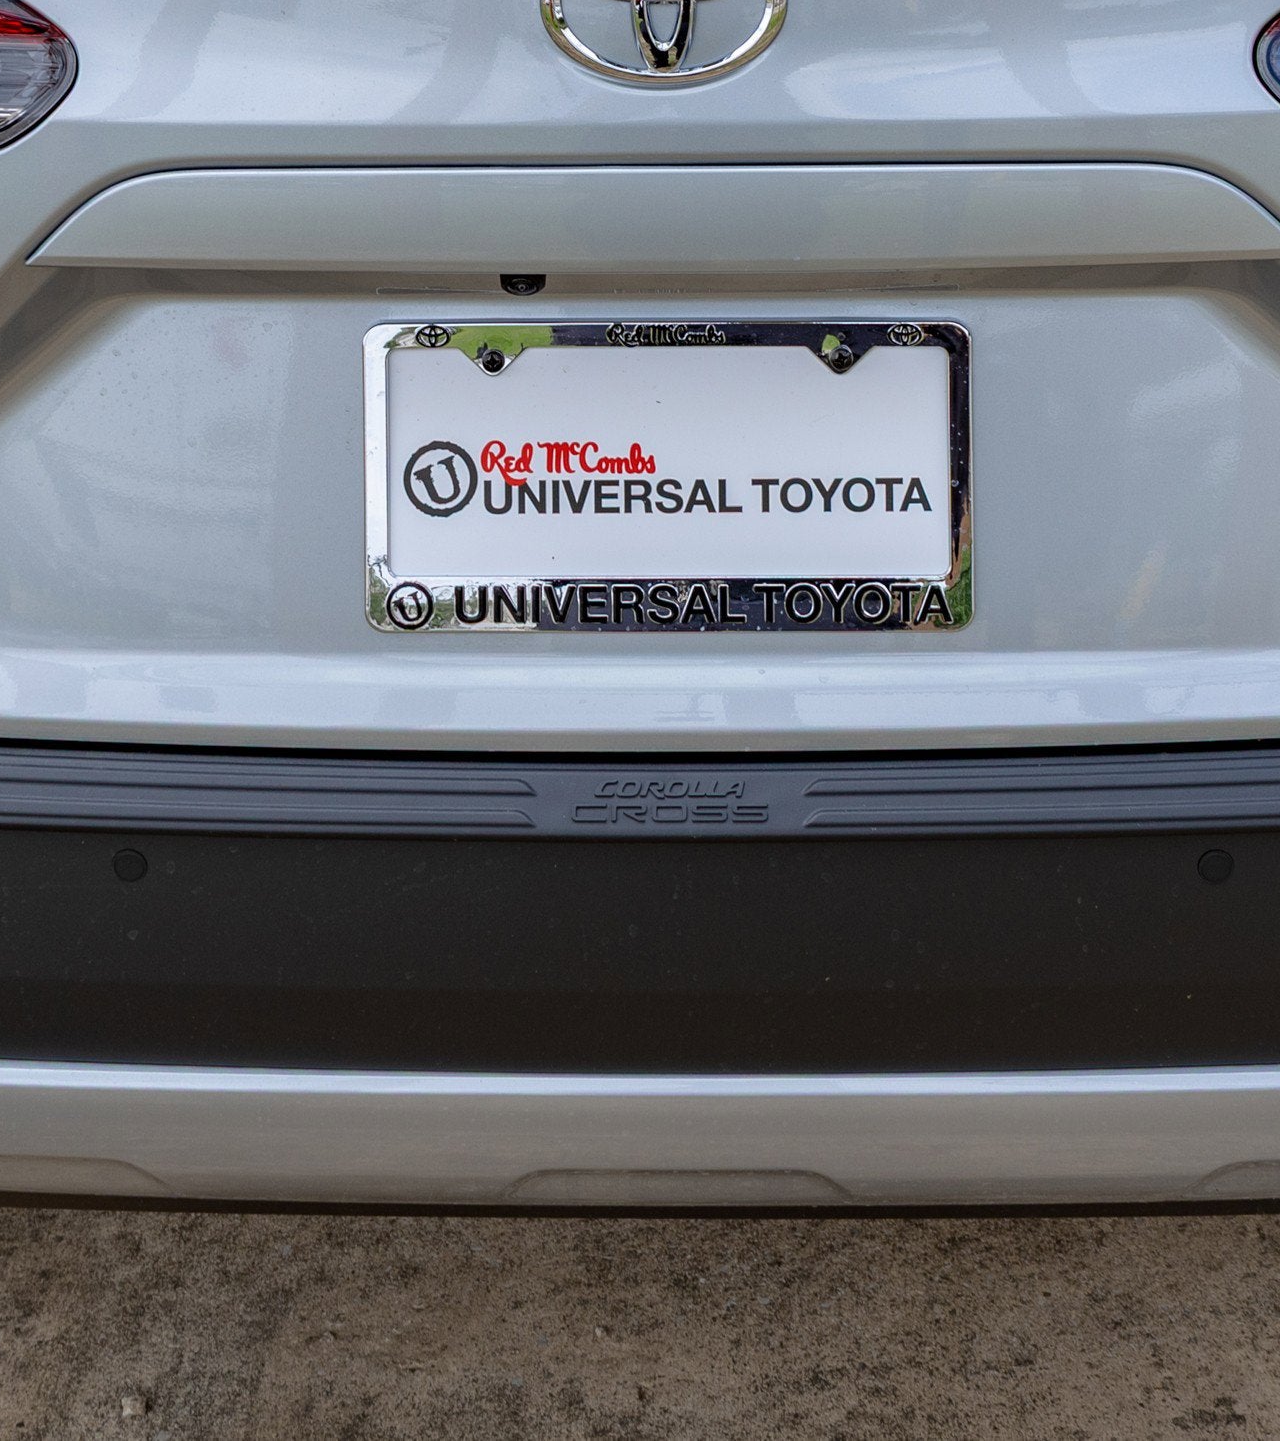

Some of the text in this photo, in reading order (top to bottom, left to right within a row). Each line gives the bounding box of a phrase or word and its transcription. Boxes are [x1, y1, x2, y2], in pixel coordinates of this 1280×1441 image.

[606, 323, 644, 348] Red
[481, 440, 656, 486] Red McCombs
[483, 477, 932, 514] UNIVERSAL TOYOTA
[454, 583, 954, 625] UNIVERSAL TOYOTA
[594, 780, 746, 799] COROLLA
[571, 804, 769, 823] CROSS
